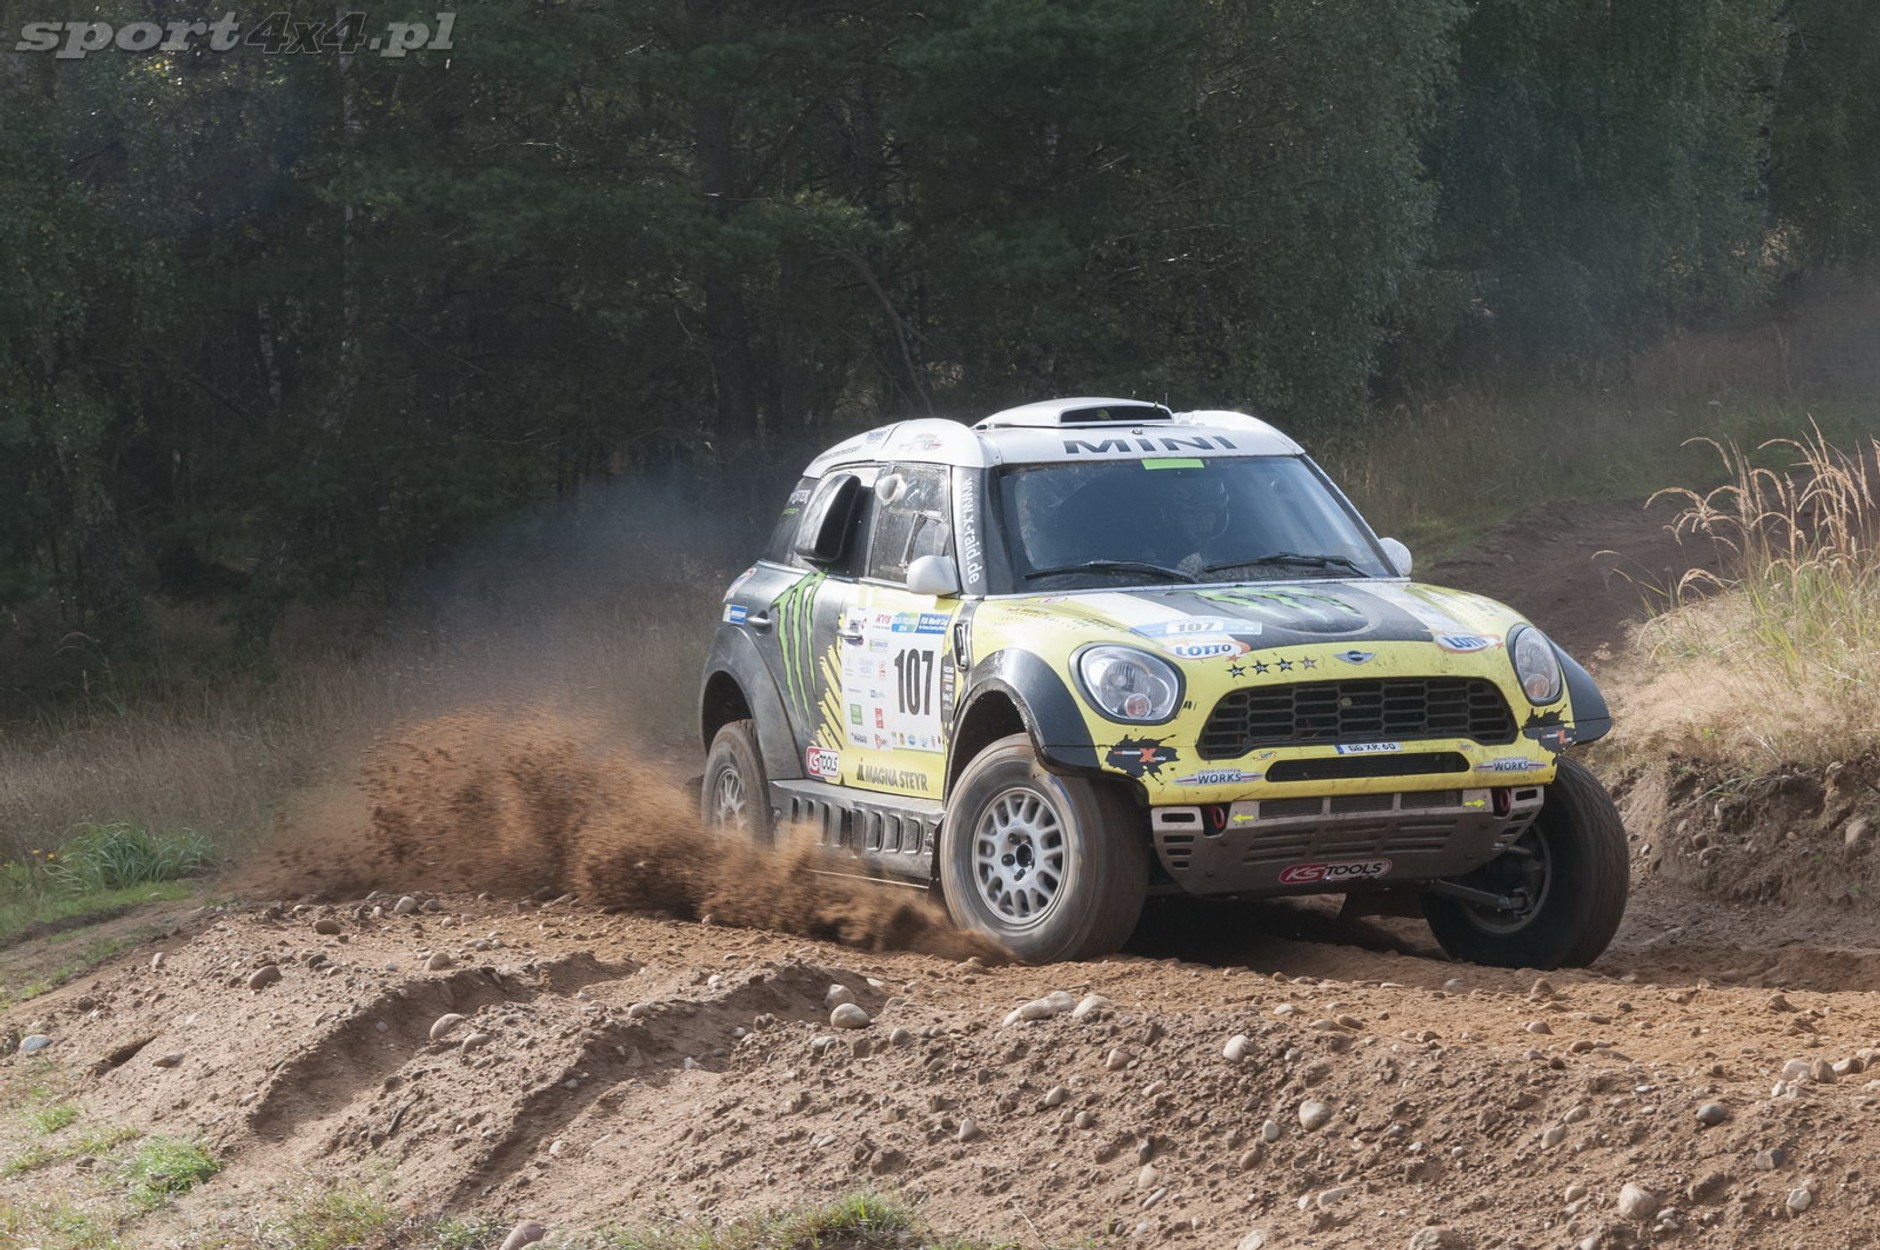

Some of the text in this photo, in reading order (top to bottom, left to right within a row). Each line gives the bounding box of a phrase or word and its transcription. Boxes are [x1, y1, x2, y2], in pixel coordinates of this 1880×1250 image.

[1063, 436, 1237, 454] MINI
[960, 477, 983, 584] www.x-raid.de
[1176, 623, 1216, 632] 107
[1175, 644, 1232, 656] LOTTO
[894, 648, 934, 715] 107
[808, 751, 838, 772] KS TOOLS
[1494, 761, 1529, 771] WORKS
[865, 765, 928, 791] MAGNA STEYR
[1198, 773, 1242, 784] WORKS
[1285, 863, 1383, 881] KS TOOLS
